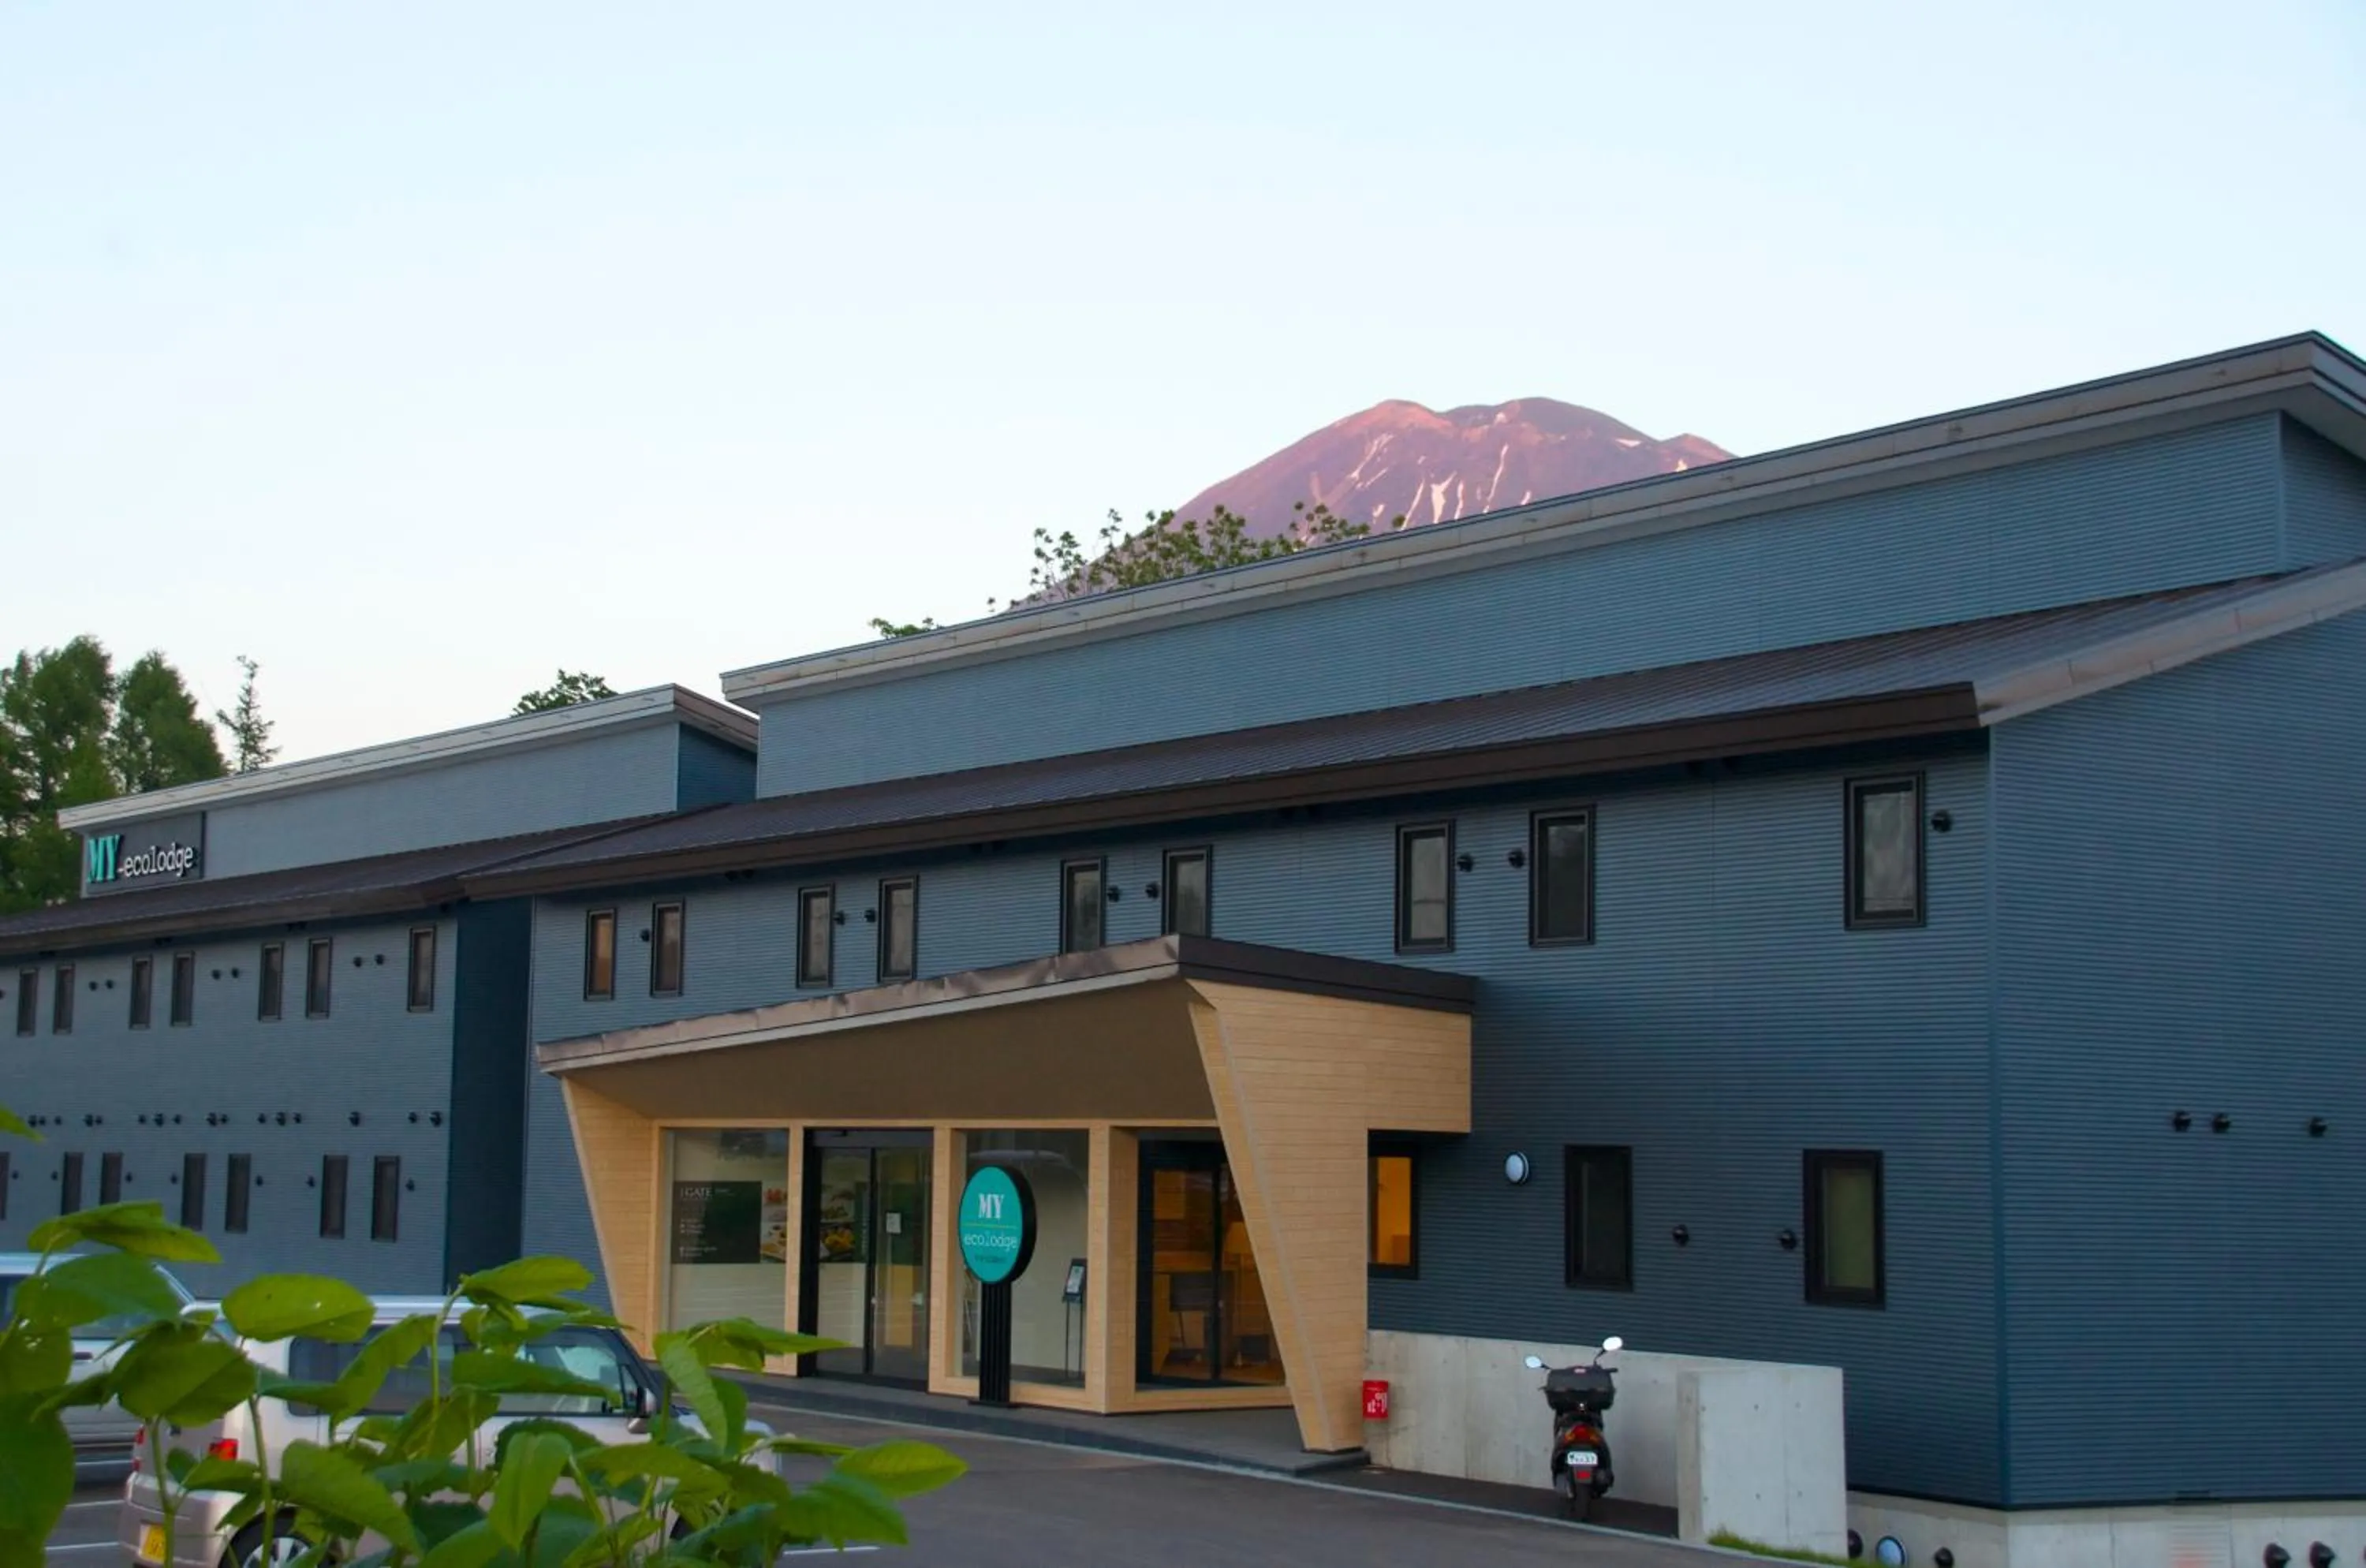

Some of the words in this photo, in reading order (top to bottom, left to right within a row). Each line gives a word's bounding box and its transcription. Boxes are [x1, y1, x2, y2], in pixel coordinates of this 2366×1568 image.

[87, 834, 121, 884] MY
[978, 1193, 1006, 1219] MY
[964, 1230, 1019, 1253] ecolodge
